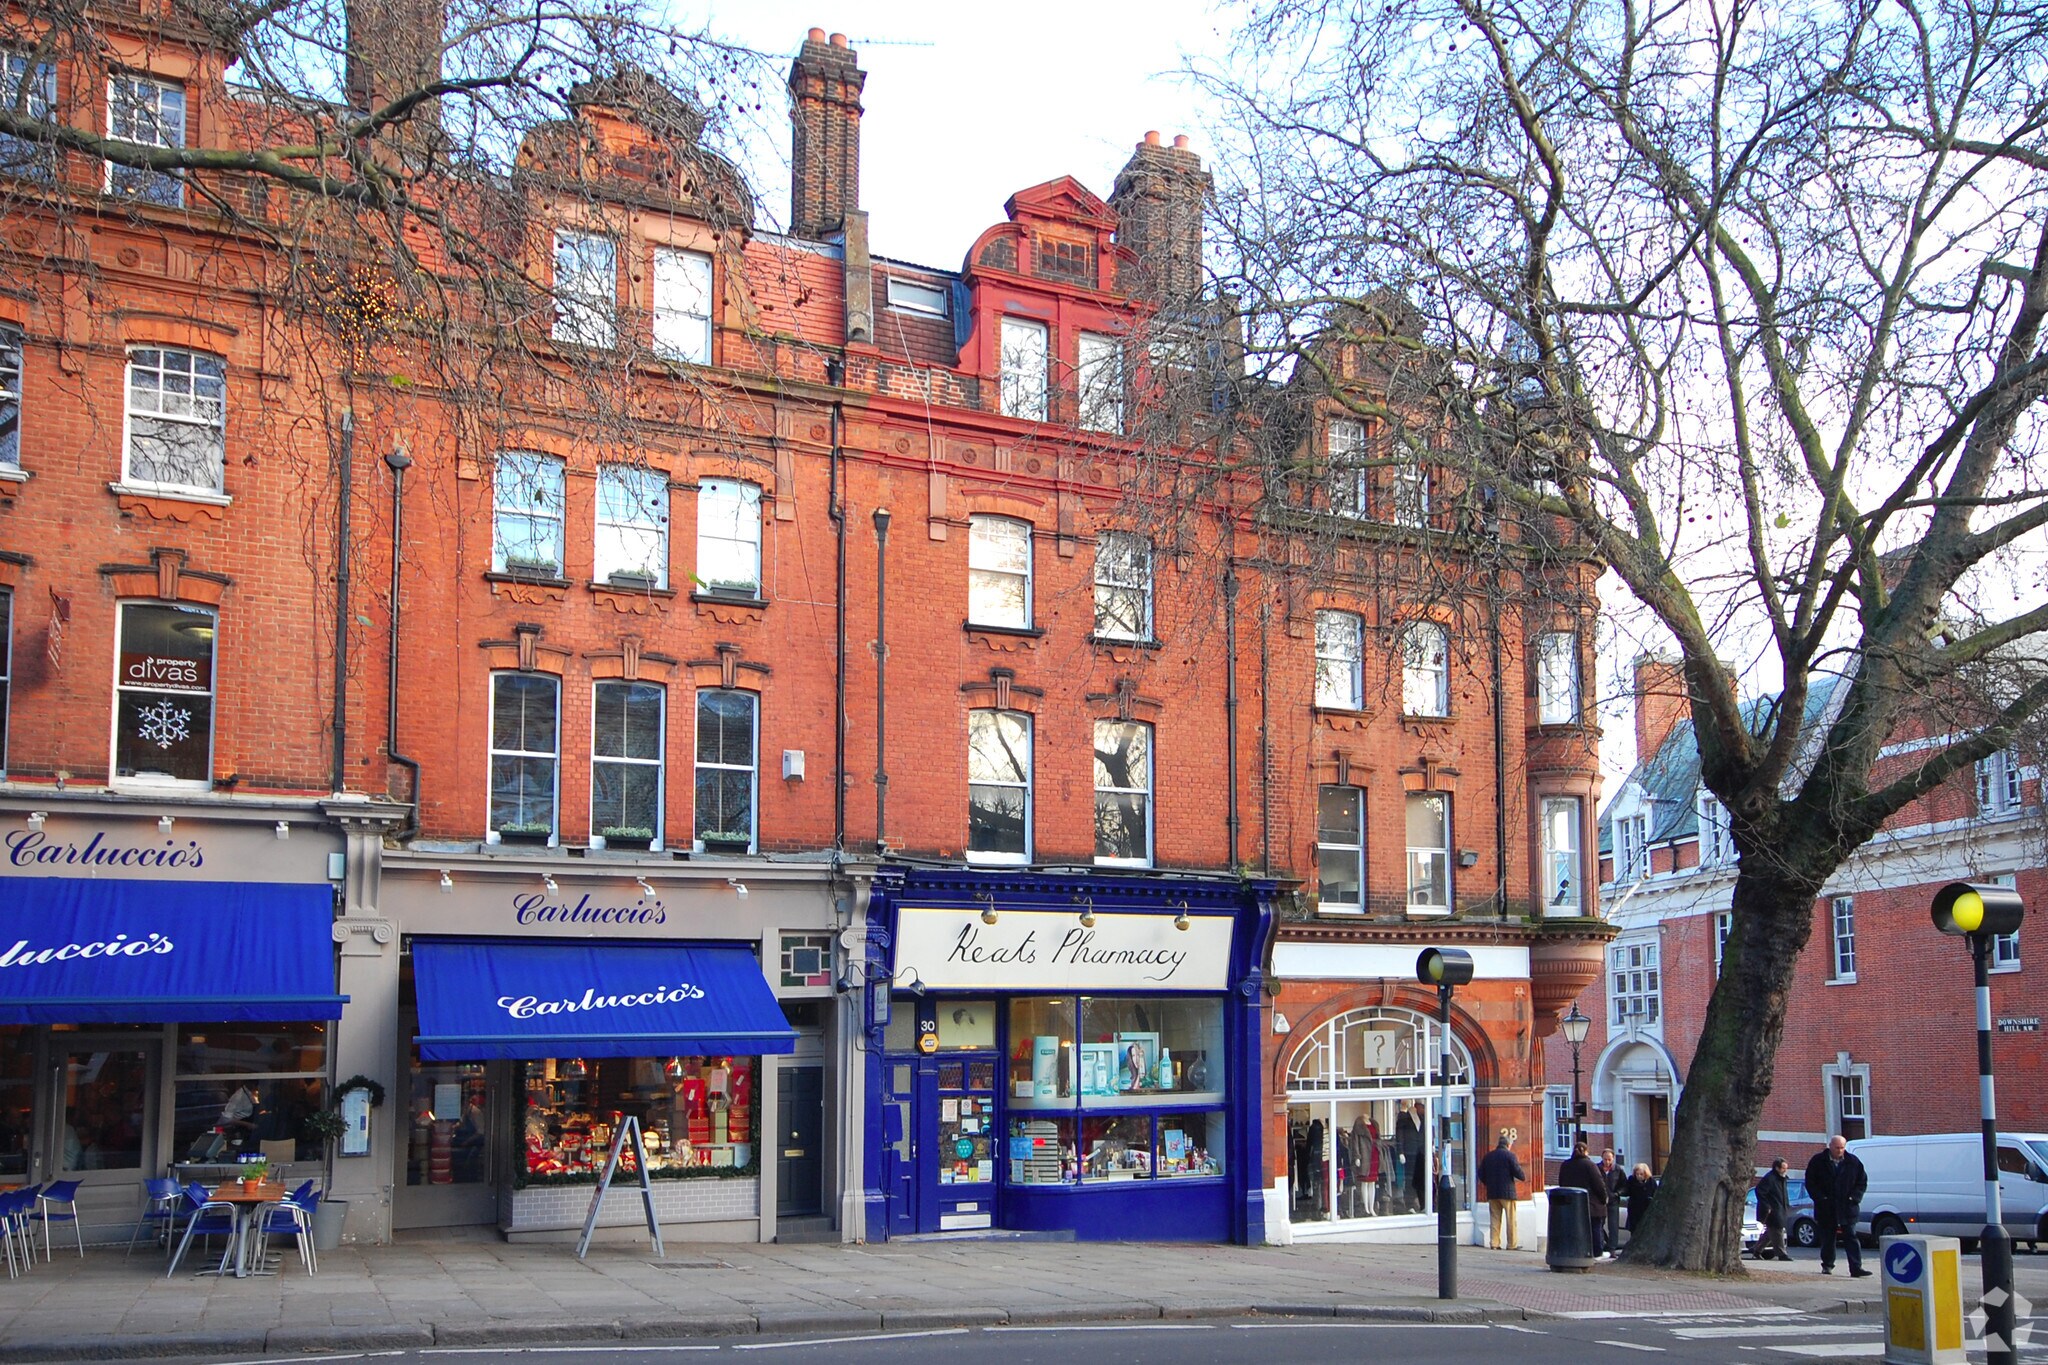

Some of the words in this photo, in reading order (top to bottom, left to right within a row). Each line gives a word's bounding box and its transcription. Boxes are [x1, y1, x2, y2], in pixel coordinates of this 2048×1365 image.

[129, 656, 198, 682] divas
[156, 658, 197, 668] property
[5, 830, 204, 868] Carluccio's
[513, 893, 666, 926] Carluccio's
[947, 922, 1037, 964] Keats
[1051, 927, 1189, 981] Pharmacy
[497, 983, 705, 1019] Carluccio's
[921, 1020, 935, 1031] 30
[1500, 1127, 1518, 1141] 28
